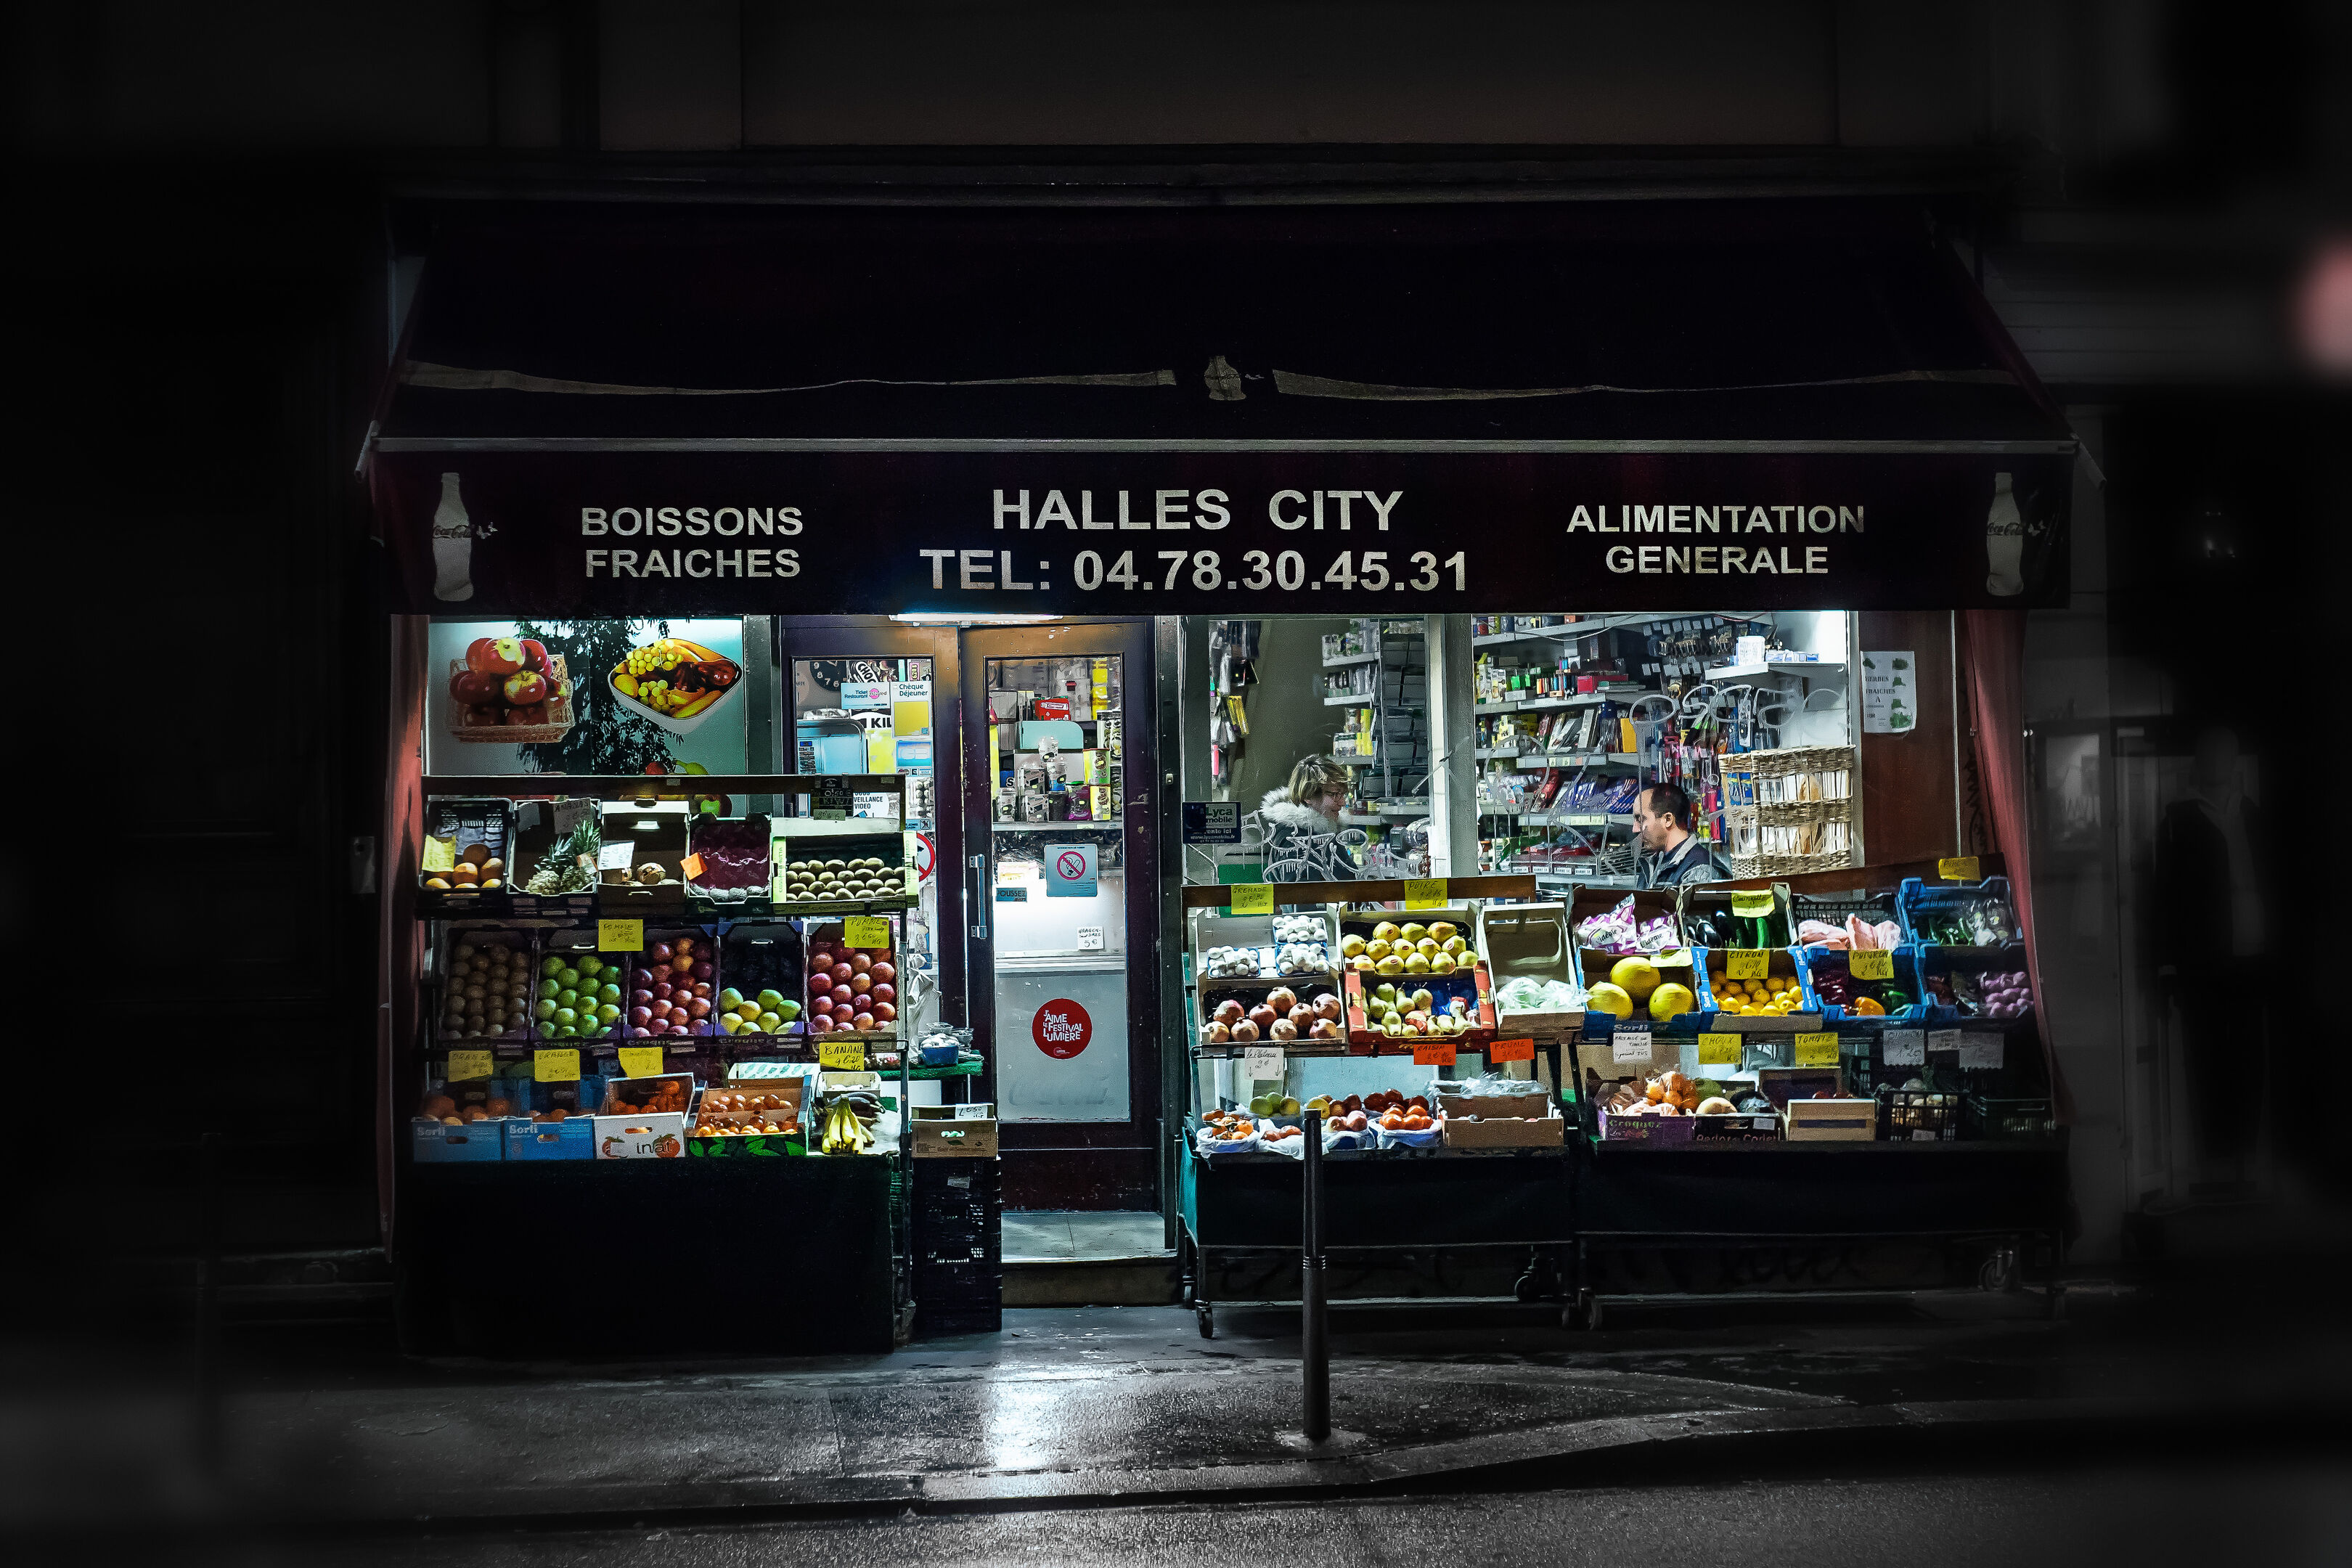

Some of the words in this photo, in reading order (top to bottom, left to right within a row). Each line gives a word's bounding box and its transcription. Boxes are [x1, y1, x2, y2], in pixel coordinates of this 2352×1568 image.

[994, 489, 1230, 531] HALLES
[1269, 489, 1404, 531] CITY
[1567, 505, 1864, 534] ALIMENTATION
[581, 507, 803, 536] BOISSONS
[585, 550, 800, 578] FRAICHES
[1606, 546, 1828, 573] GENERALE
[920, 549, 1050, 590] TEL:
[1074, 550, 1466, 591] 04.78.30.45.31
[1206, 807, 1233, 817] Lyca
[1408, 881, 1439, 891] POIRE
[1043, 1010, 1068, 1024] J'AIME
[1042, 1028, 1081, 1042] LUMIÈRE
[1048, 1023, 1084, 1032] FESTIVAL
[825, 1045, 864, 1055] BANANE
